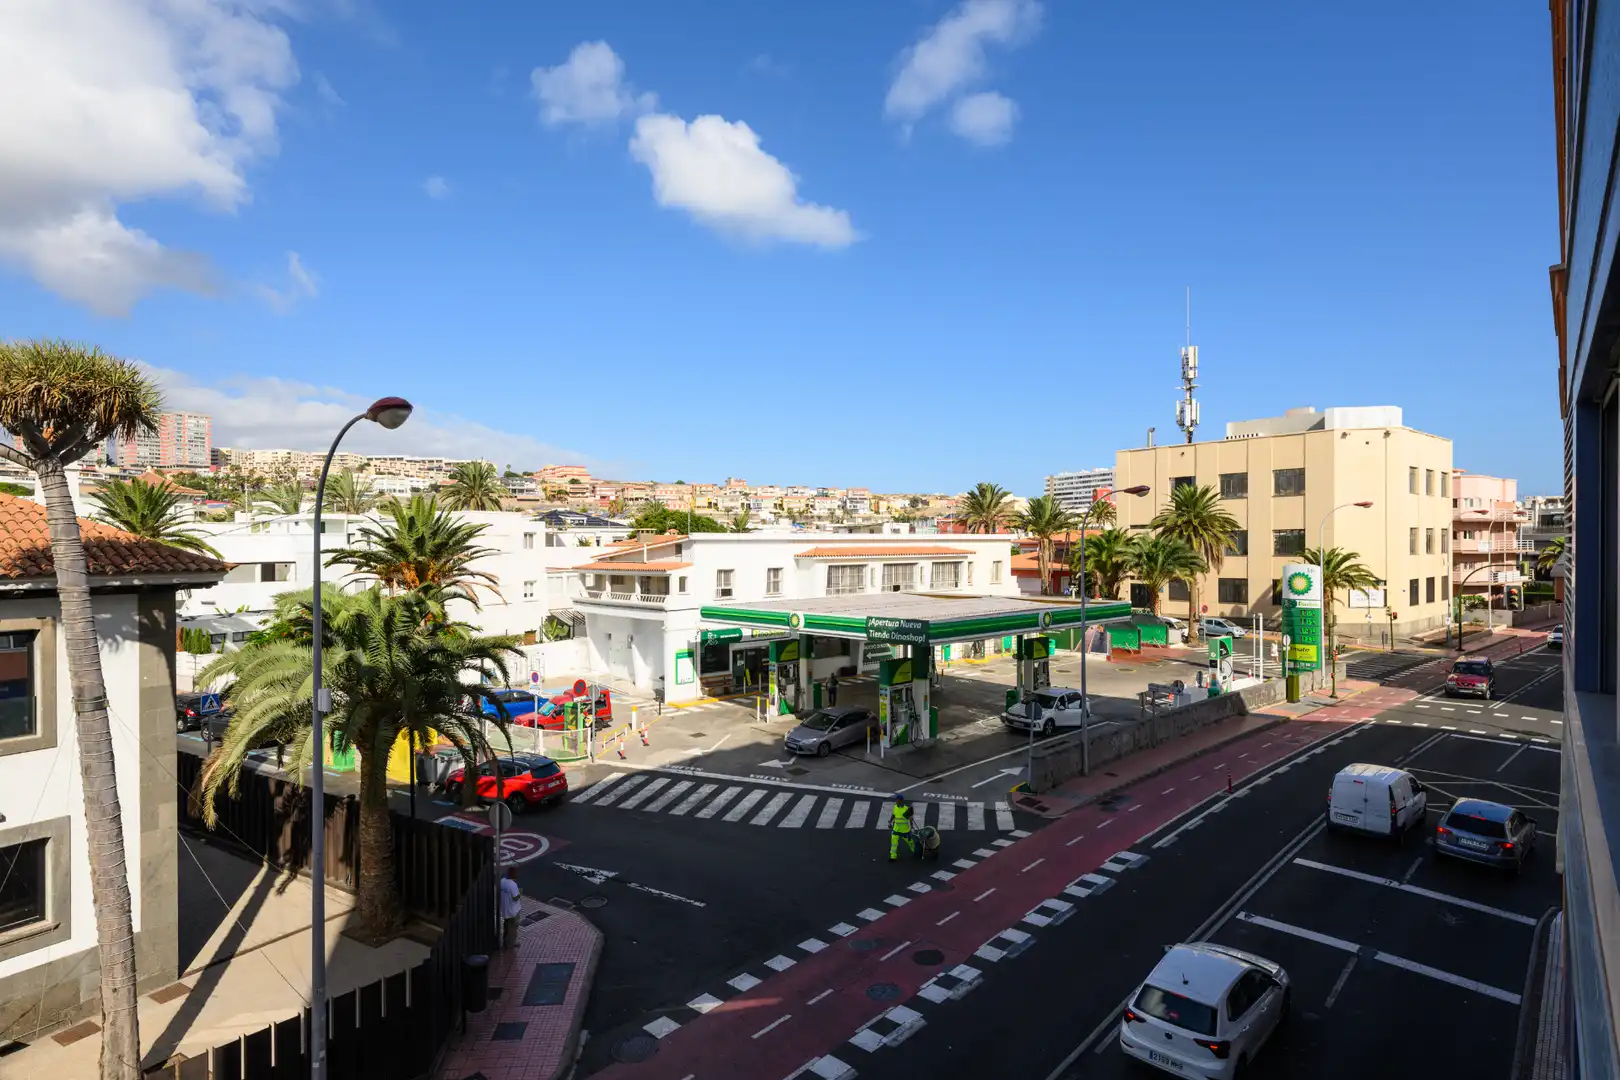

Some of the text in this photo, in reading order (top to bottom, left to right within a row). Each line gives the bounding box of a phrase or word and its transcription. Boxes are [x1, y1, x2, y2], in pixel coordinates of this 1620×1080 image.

[868, 617, 922, 629] ¡Apertura Nueva
[869, 629, 926, 643] Tienda Dinoshop!
[923, 792, 969, 801] ENTRADA
